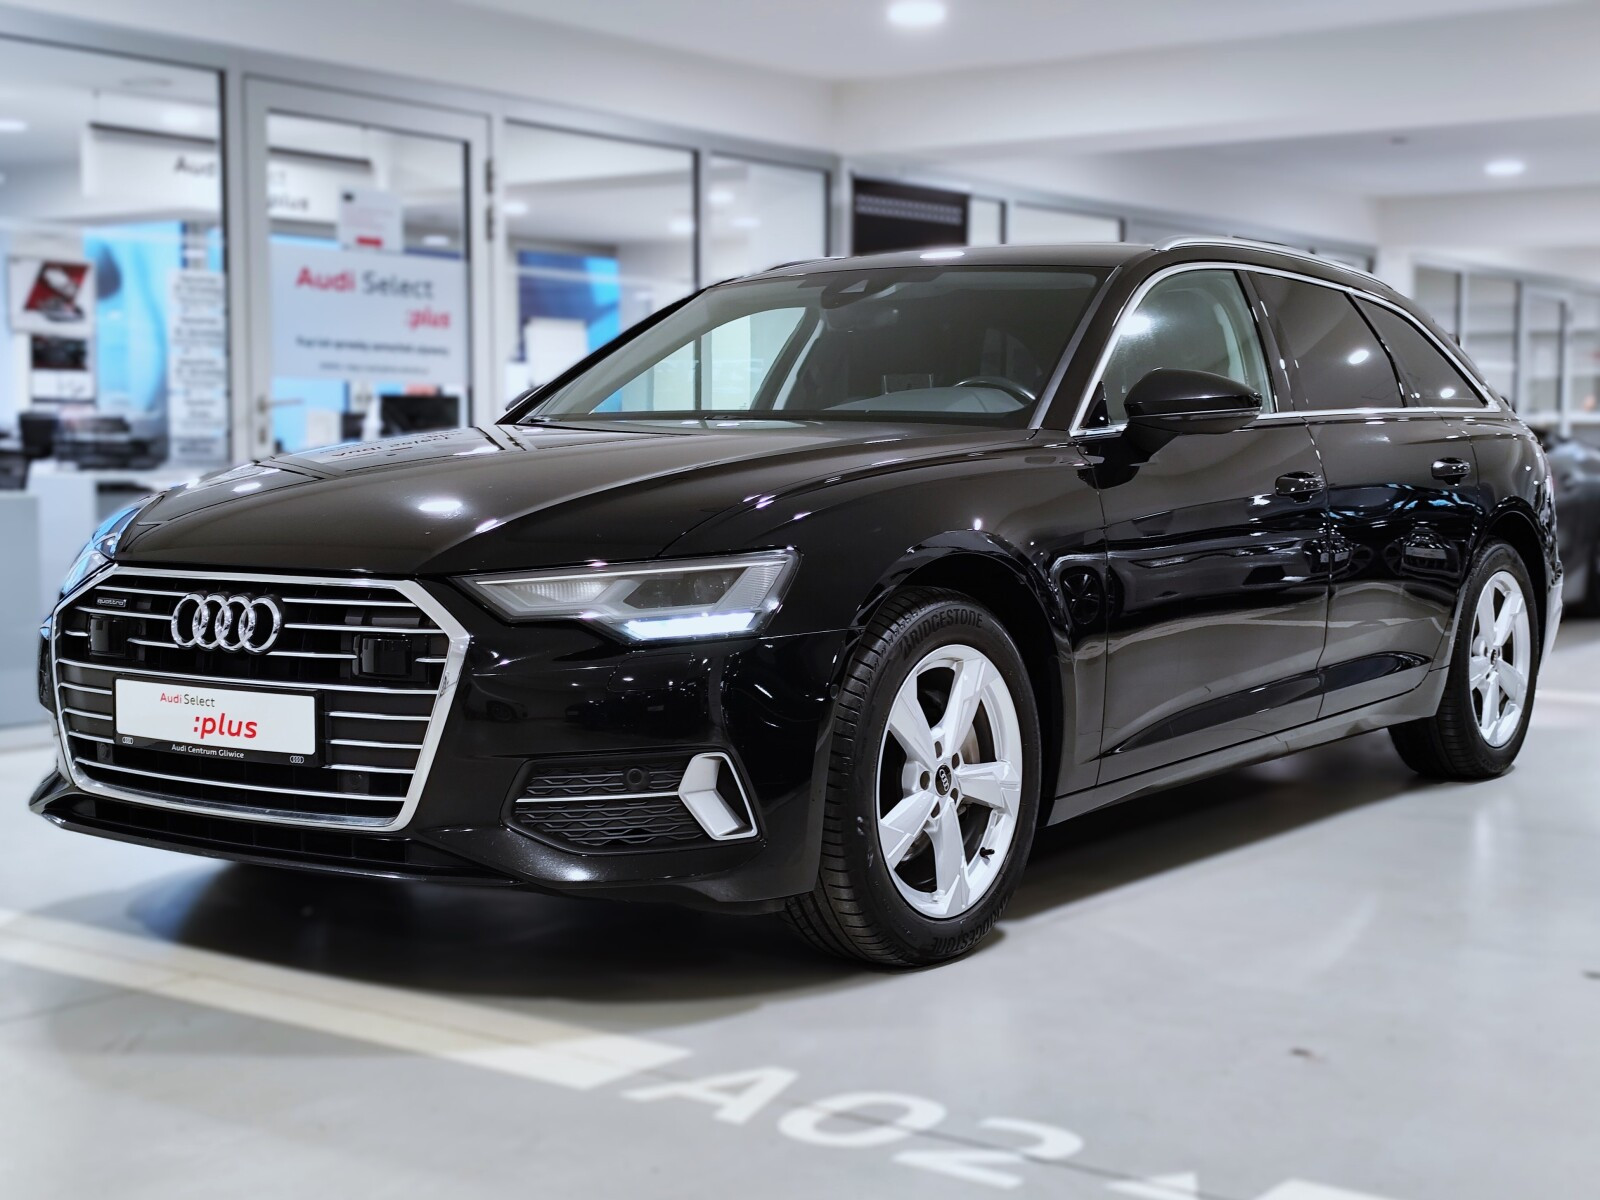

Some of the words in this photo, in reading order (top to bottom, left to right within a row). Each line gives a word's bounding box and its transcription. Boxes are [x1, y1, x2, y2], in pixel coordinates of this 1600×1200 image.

[296, 267, 356, 292] Audi
[361, 269, 434, 299] Select
[97, 598, 124, 606] quattro
[900, 608, 983, 660] BRIDGESTONE
[160, 692, 182, 704] Audi
[184, 694, 215, 708] Select
[193, 713, 258, 739] :plus
[171, 744, 187, 753] Audi
[188, 746, 217, 757] Centrum
[218, 749, 245, 759] Gliwice
